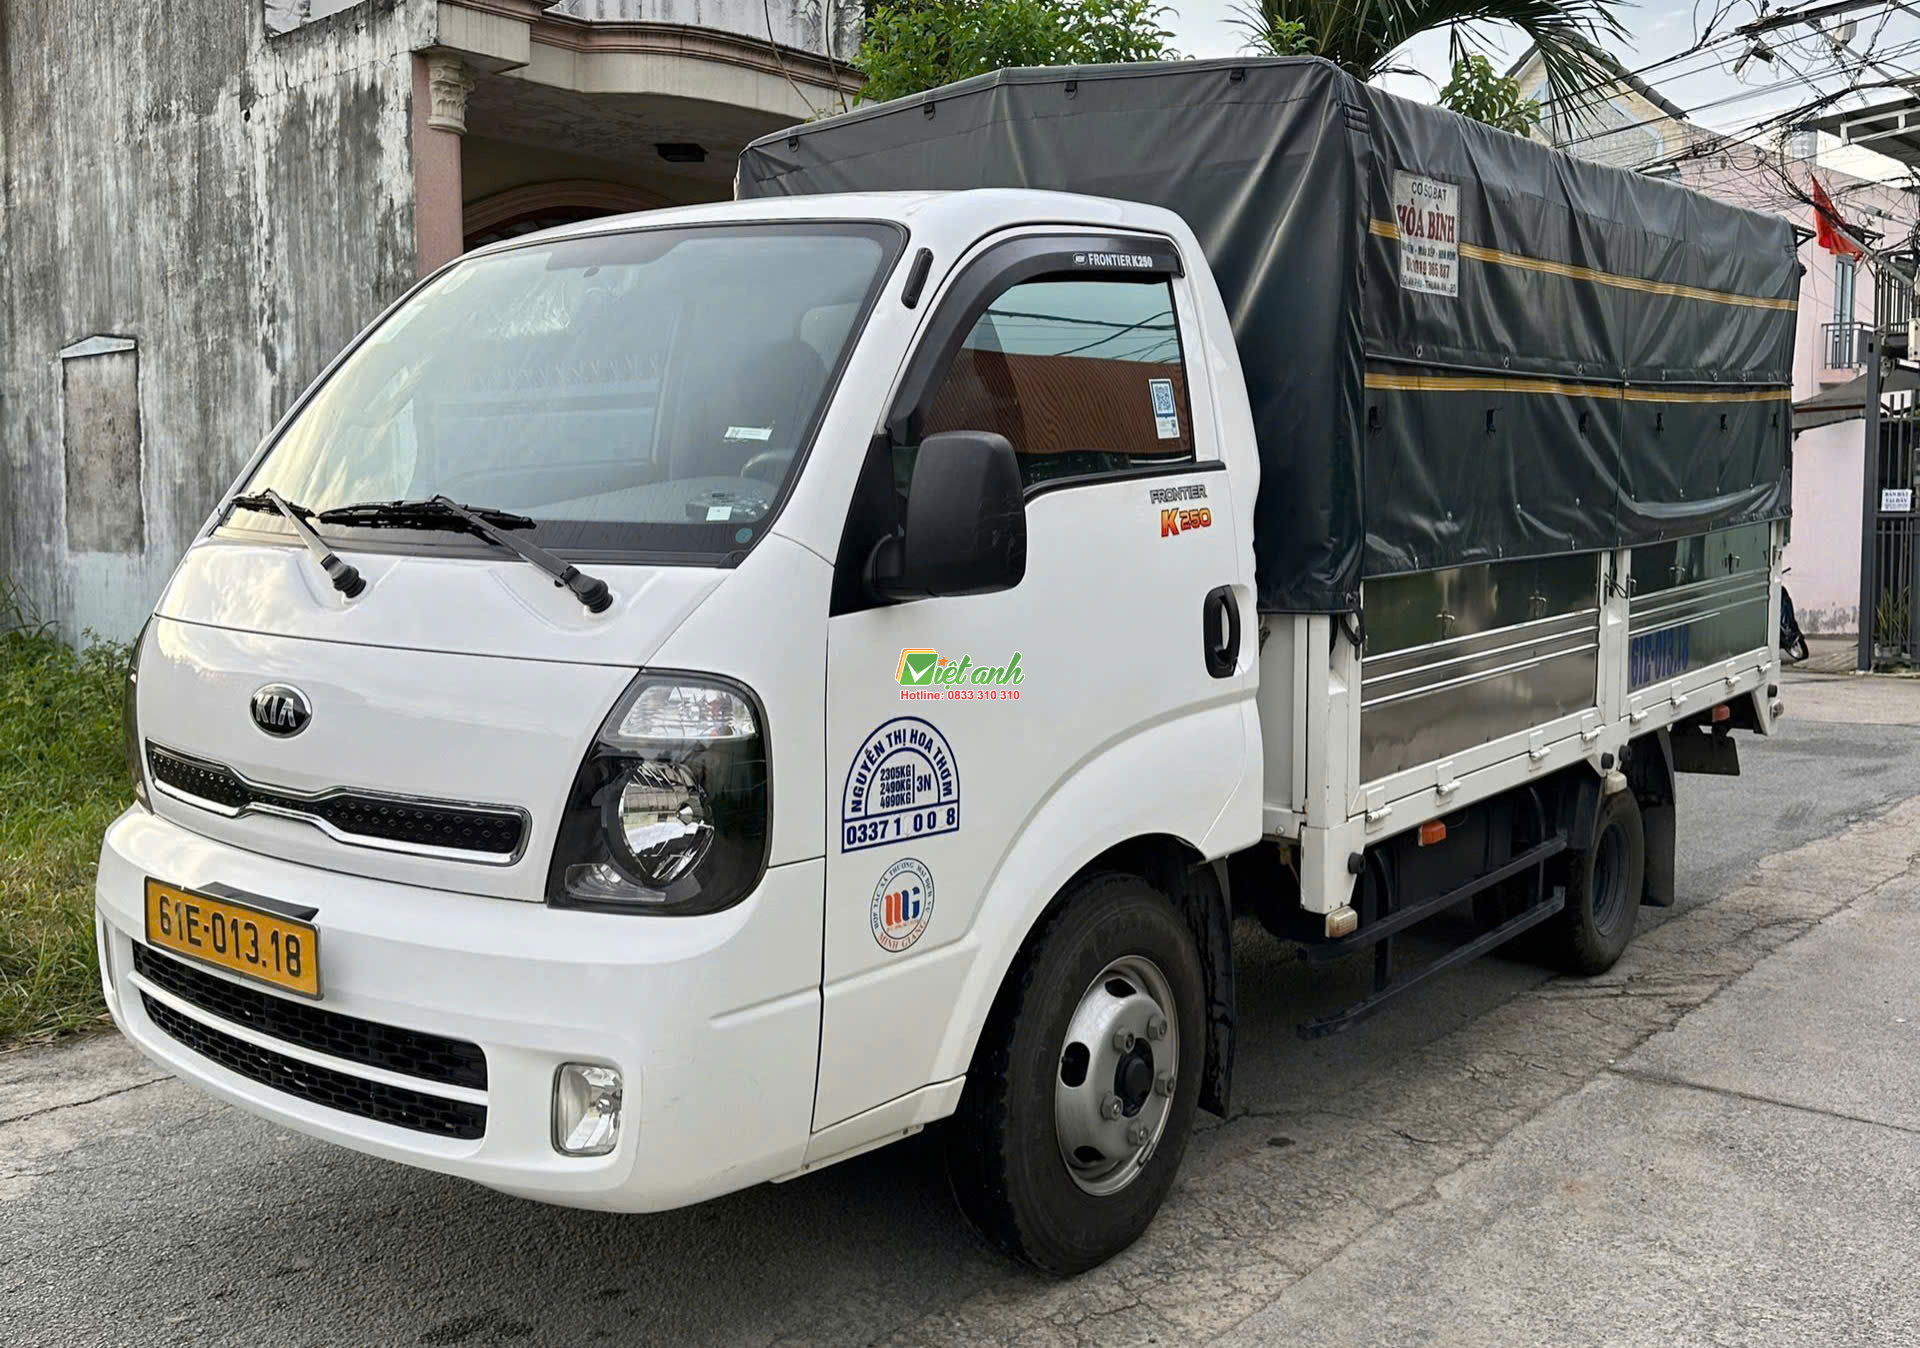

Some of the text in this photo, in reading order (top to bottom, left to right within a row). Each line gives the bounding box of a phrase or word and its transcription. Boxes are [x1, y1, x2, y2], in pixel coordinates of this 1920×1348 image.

[1396, 198, 1455, 243] HÒA BÌNH
[1087, 253, 1132, 267] FRONTIER
[1132, 255, 1153, 268] K250
[1149, 484, 1207, 504] FRONTIER
[1161, 507, 1211, 538] K250
[255, 693, 297, 727] KIA
[885, 728, 907, 748] THỊ
[909, 728, 934, 754] HOA
[880, 764, 911, 782] 2305KG
[916, 773, 932, 792] 3N
[880, 778, 911, 796] 2490KG
[880, 791, 911, 809] 4990KG
[159, 895, 302, 978] 61E-013.18
